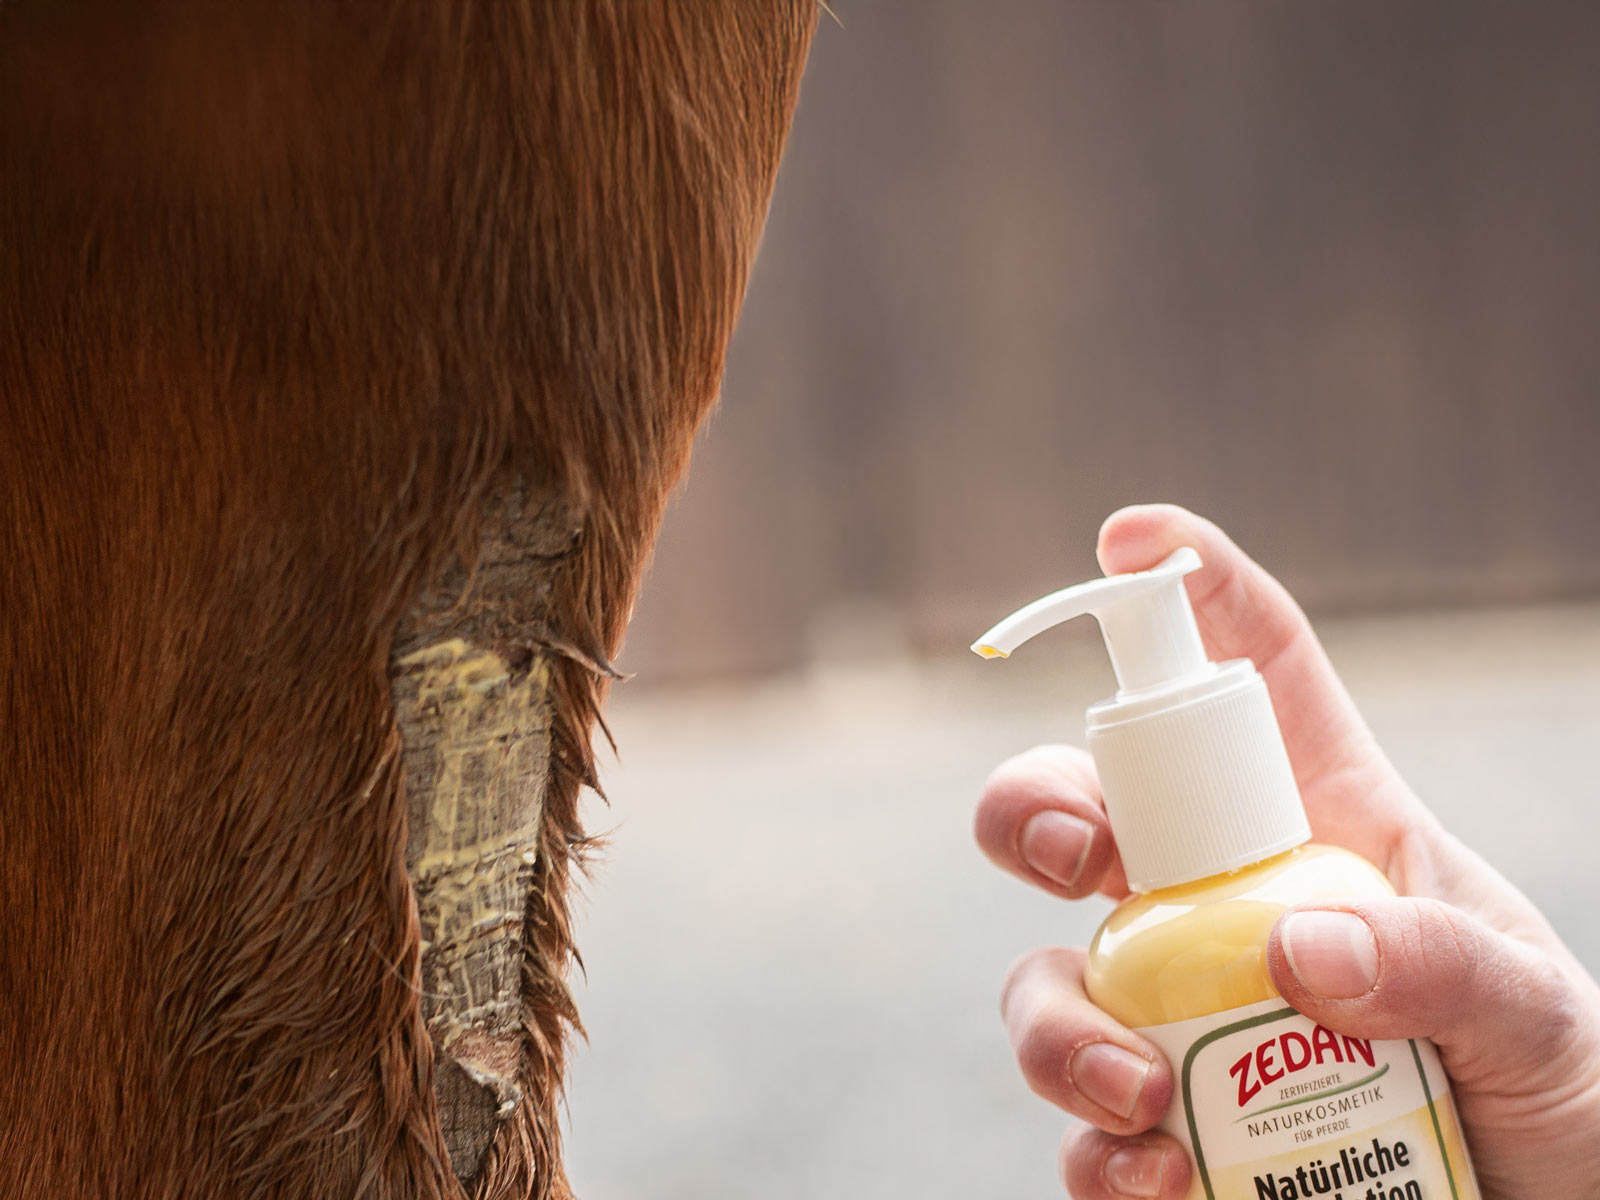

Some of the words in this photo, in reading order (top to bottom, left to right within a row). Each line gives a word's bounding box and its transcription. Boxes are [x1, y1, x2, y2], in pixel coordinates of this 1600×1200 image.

[1229, 1024, 1376, 1107] ZEDAN
[1280, 1073, 1343, 1100] ZERTIFIZIERTE
[1247, 1086, 1384, 1138] NATURKOSMETIK
[1294, 1128, 1314, 1143] FÜR
[1317, 1119, 1351, 1140] PFERDE
